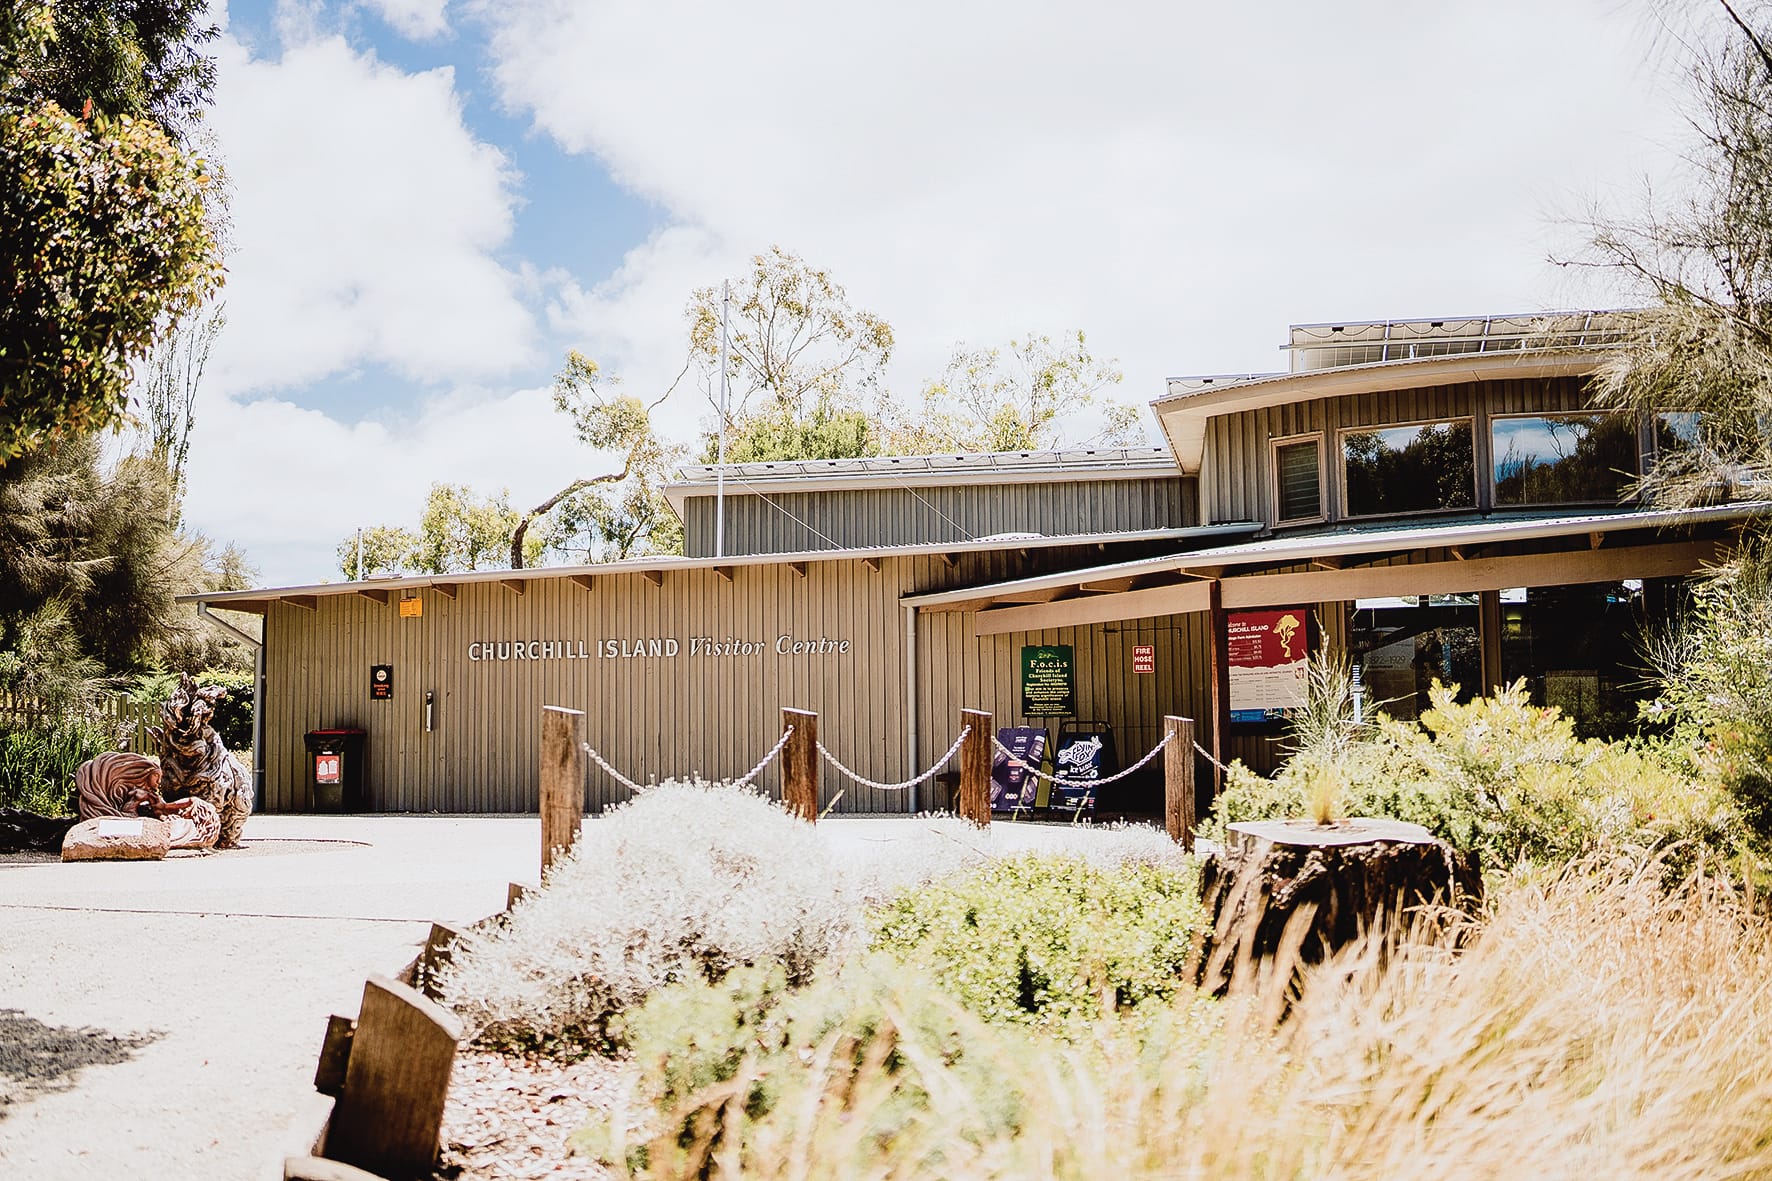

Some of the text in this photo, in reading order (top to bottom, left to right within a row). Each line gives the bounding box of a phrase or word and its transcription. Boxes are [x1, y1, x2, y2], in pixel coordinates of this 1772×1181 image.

[468, 635, 850, 661] CHURCHILL ISLAND Visitor Centre
[1030, 659, 1068, 668] F.o.c.i.s
[1075, 750, 1092, 762] FOX
